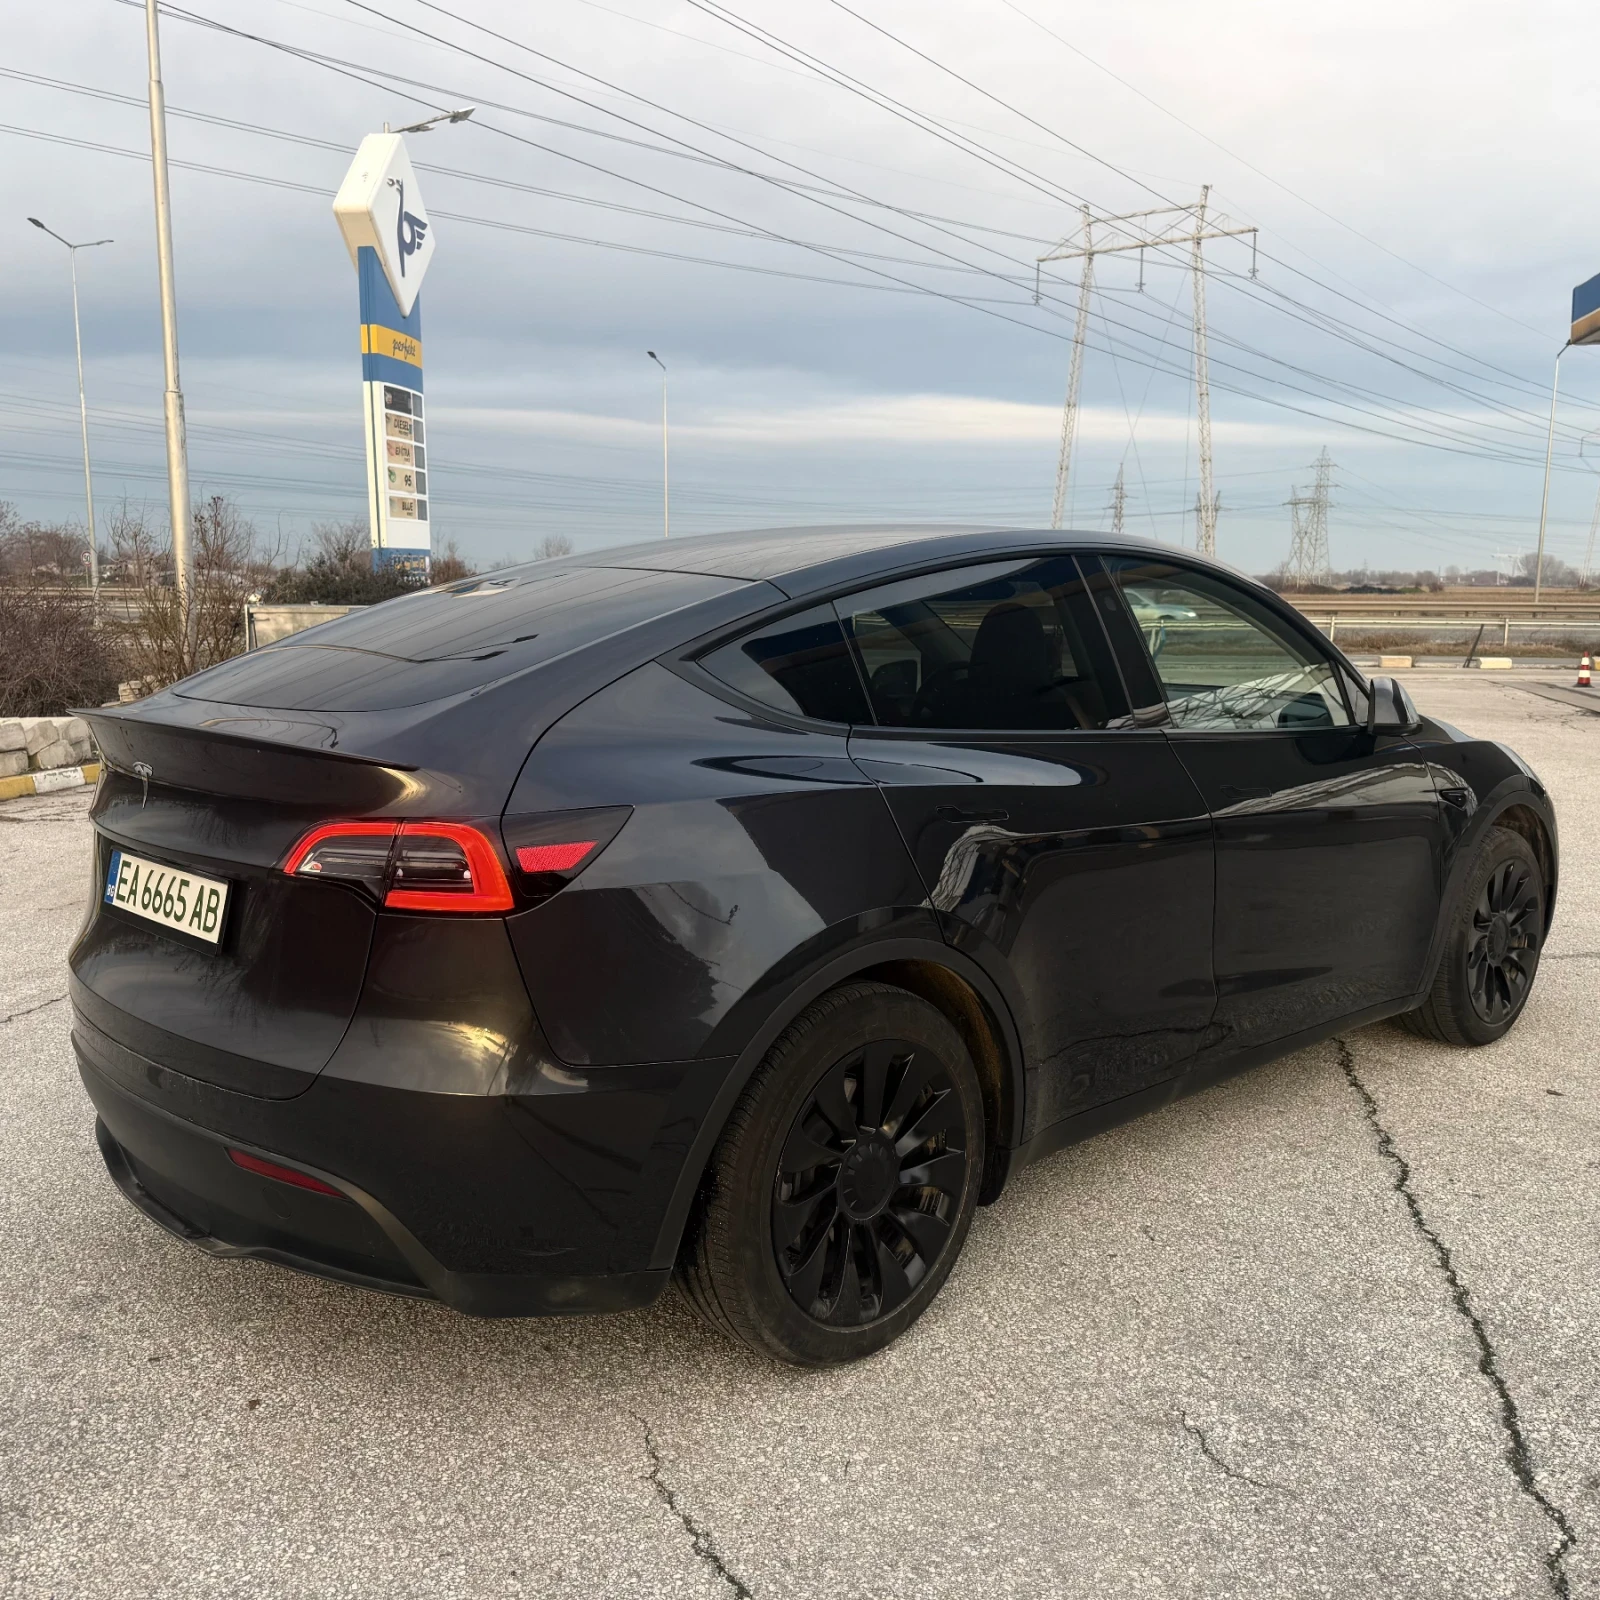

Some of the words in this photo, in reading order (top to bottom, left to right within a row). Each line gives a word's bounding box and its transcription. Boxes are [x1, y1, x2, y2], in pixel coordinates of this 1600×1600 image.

[394, 418, 410, 431] DIESEL
[404, 474, 412, 487] 95
[402, 501, 414, 512] BLUE
[106, 884, 115, 897] BG
[115, 859, 140, 907] EA
[141, 869, 188, 923] 6665
[188, 884, 221, 934] AB
